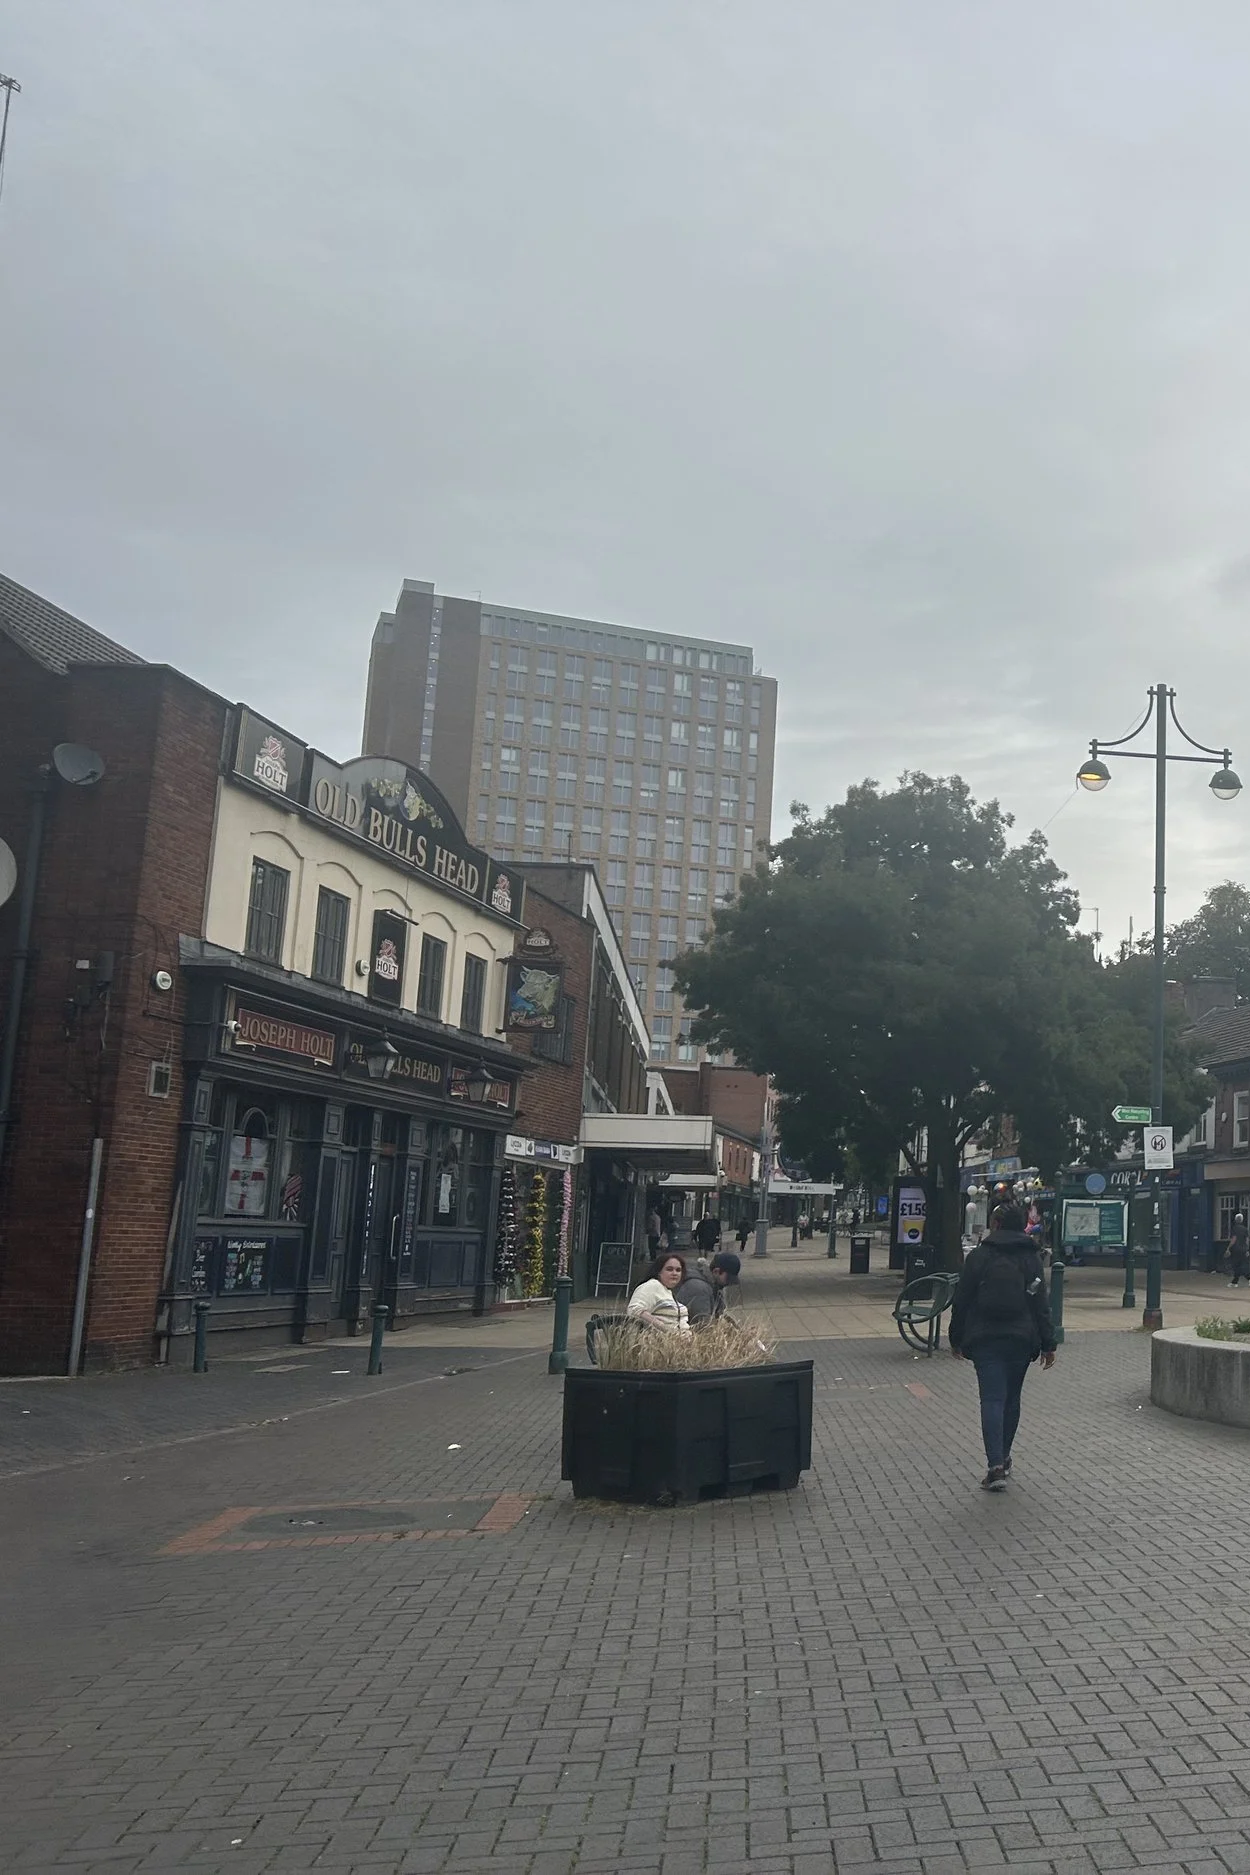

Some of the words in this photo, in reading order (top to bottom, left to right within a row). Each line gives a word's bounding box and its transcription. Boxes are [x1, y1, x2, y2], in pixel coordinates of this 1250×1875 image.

[256, 760, 287, 786] HOLT
[315, 777, 361, 829] OLD
[368, 806, 427, 867] BULLS
[433, 845, 480, 894] HEAD
[492, 891, 511, 911] HOLT
[528, 938, 549, 946] HOLT
[377, 961, 398, 979] HOLT
[241, 1017, 296, 1048] JOSEPH
[301, 1035, 334, 1060] HOLT
[413, 1059, 441, 1083] HEAD
